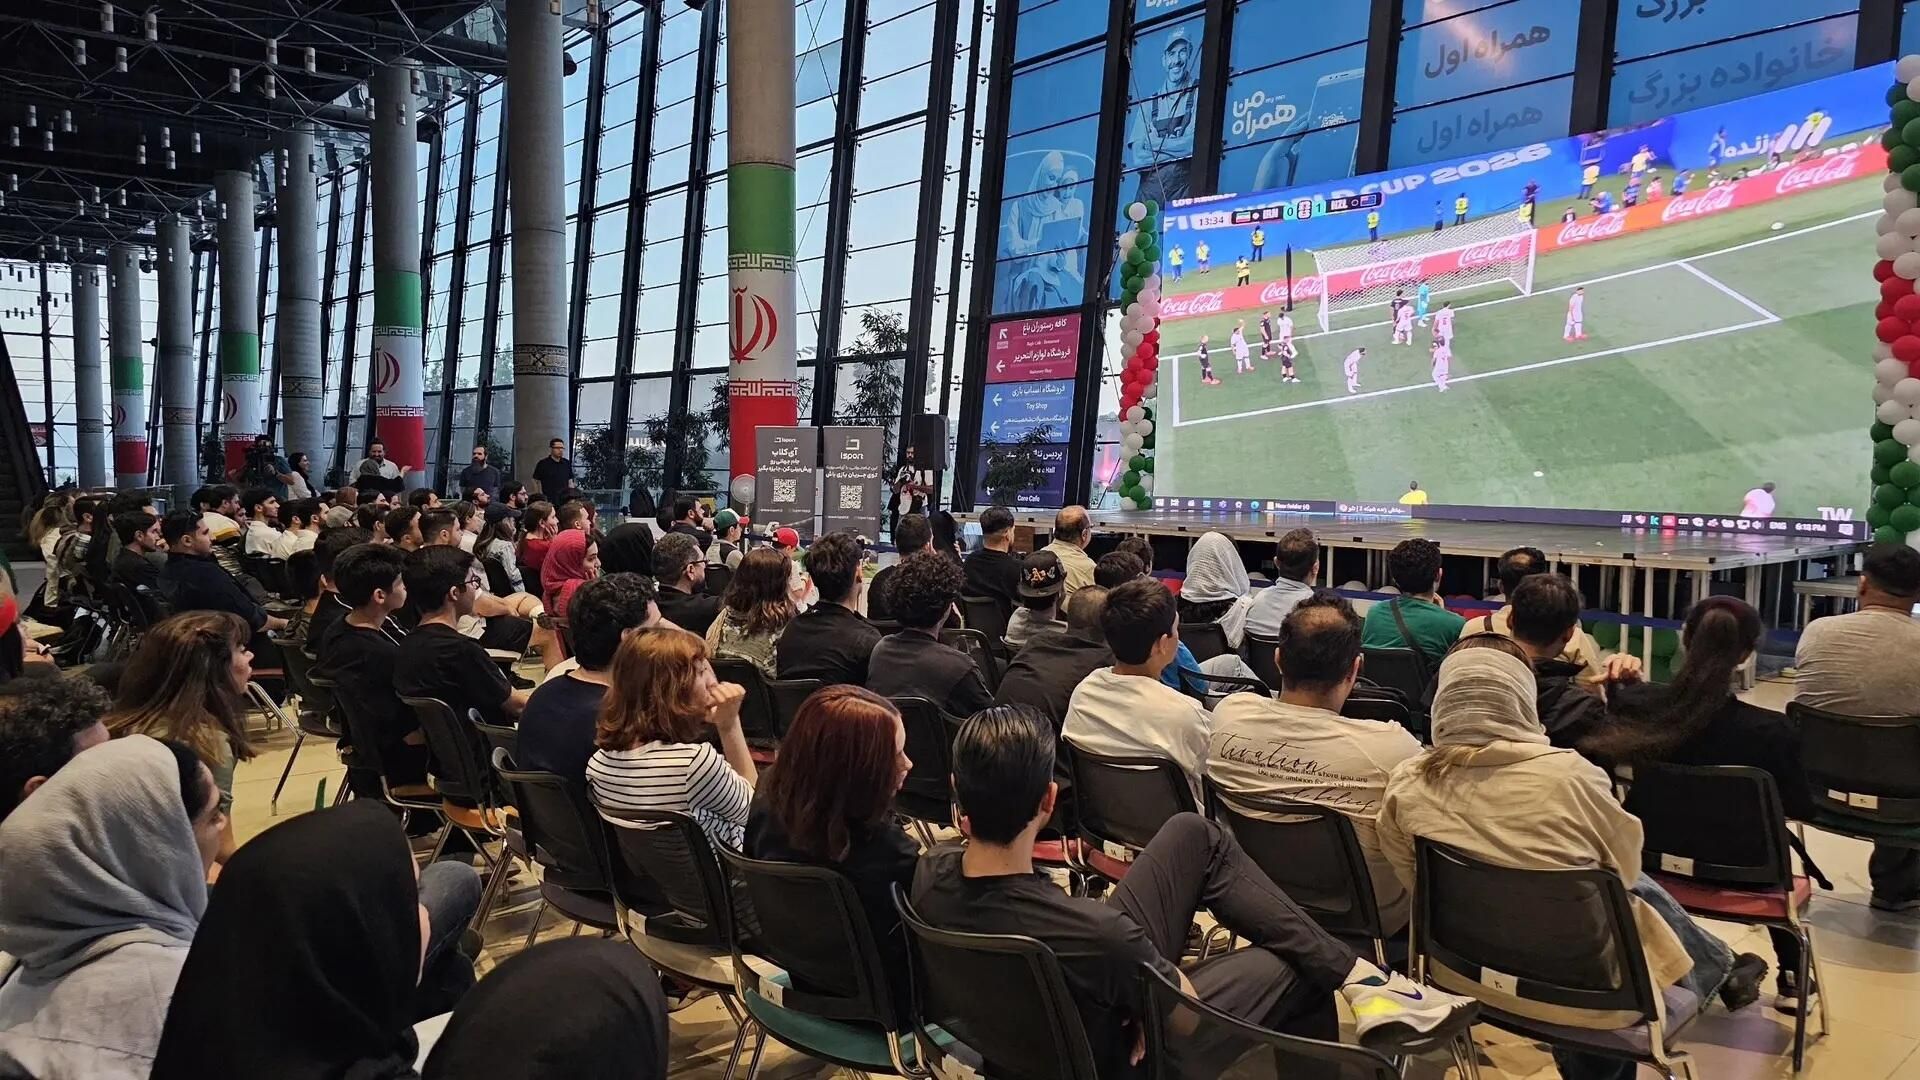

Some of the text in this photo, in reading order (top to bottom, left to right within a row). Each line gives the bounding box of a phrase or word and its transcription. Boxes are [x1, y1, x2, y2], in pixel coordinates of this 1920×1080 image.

[1424, 26, 1550, 79] همراه اول
[1629, 37, 1846, 109] خانواده بزرگ
[1232, 90, 1265, 118] من
[1232, 104, 1296, 139] همراه
[1417, 106, 1543, 154] همراه اول
[1430, 143, 1552, 185] 2026
[1199, 216, 1224, 226] 13:34
[1315, 203, 1321, 213] 1
[1047, 346, 1071, 359] فروشگاه
[1042, 383, 1066, 395] فروشگاه
[1026, 403, 1035, 411] Toy
[1812, 524, 1827, 532] PM
